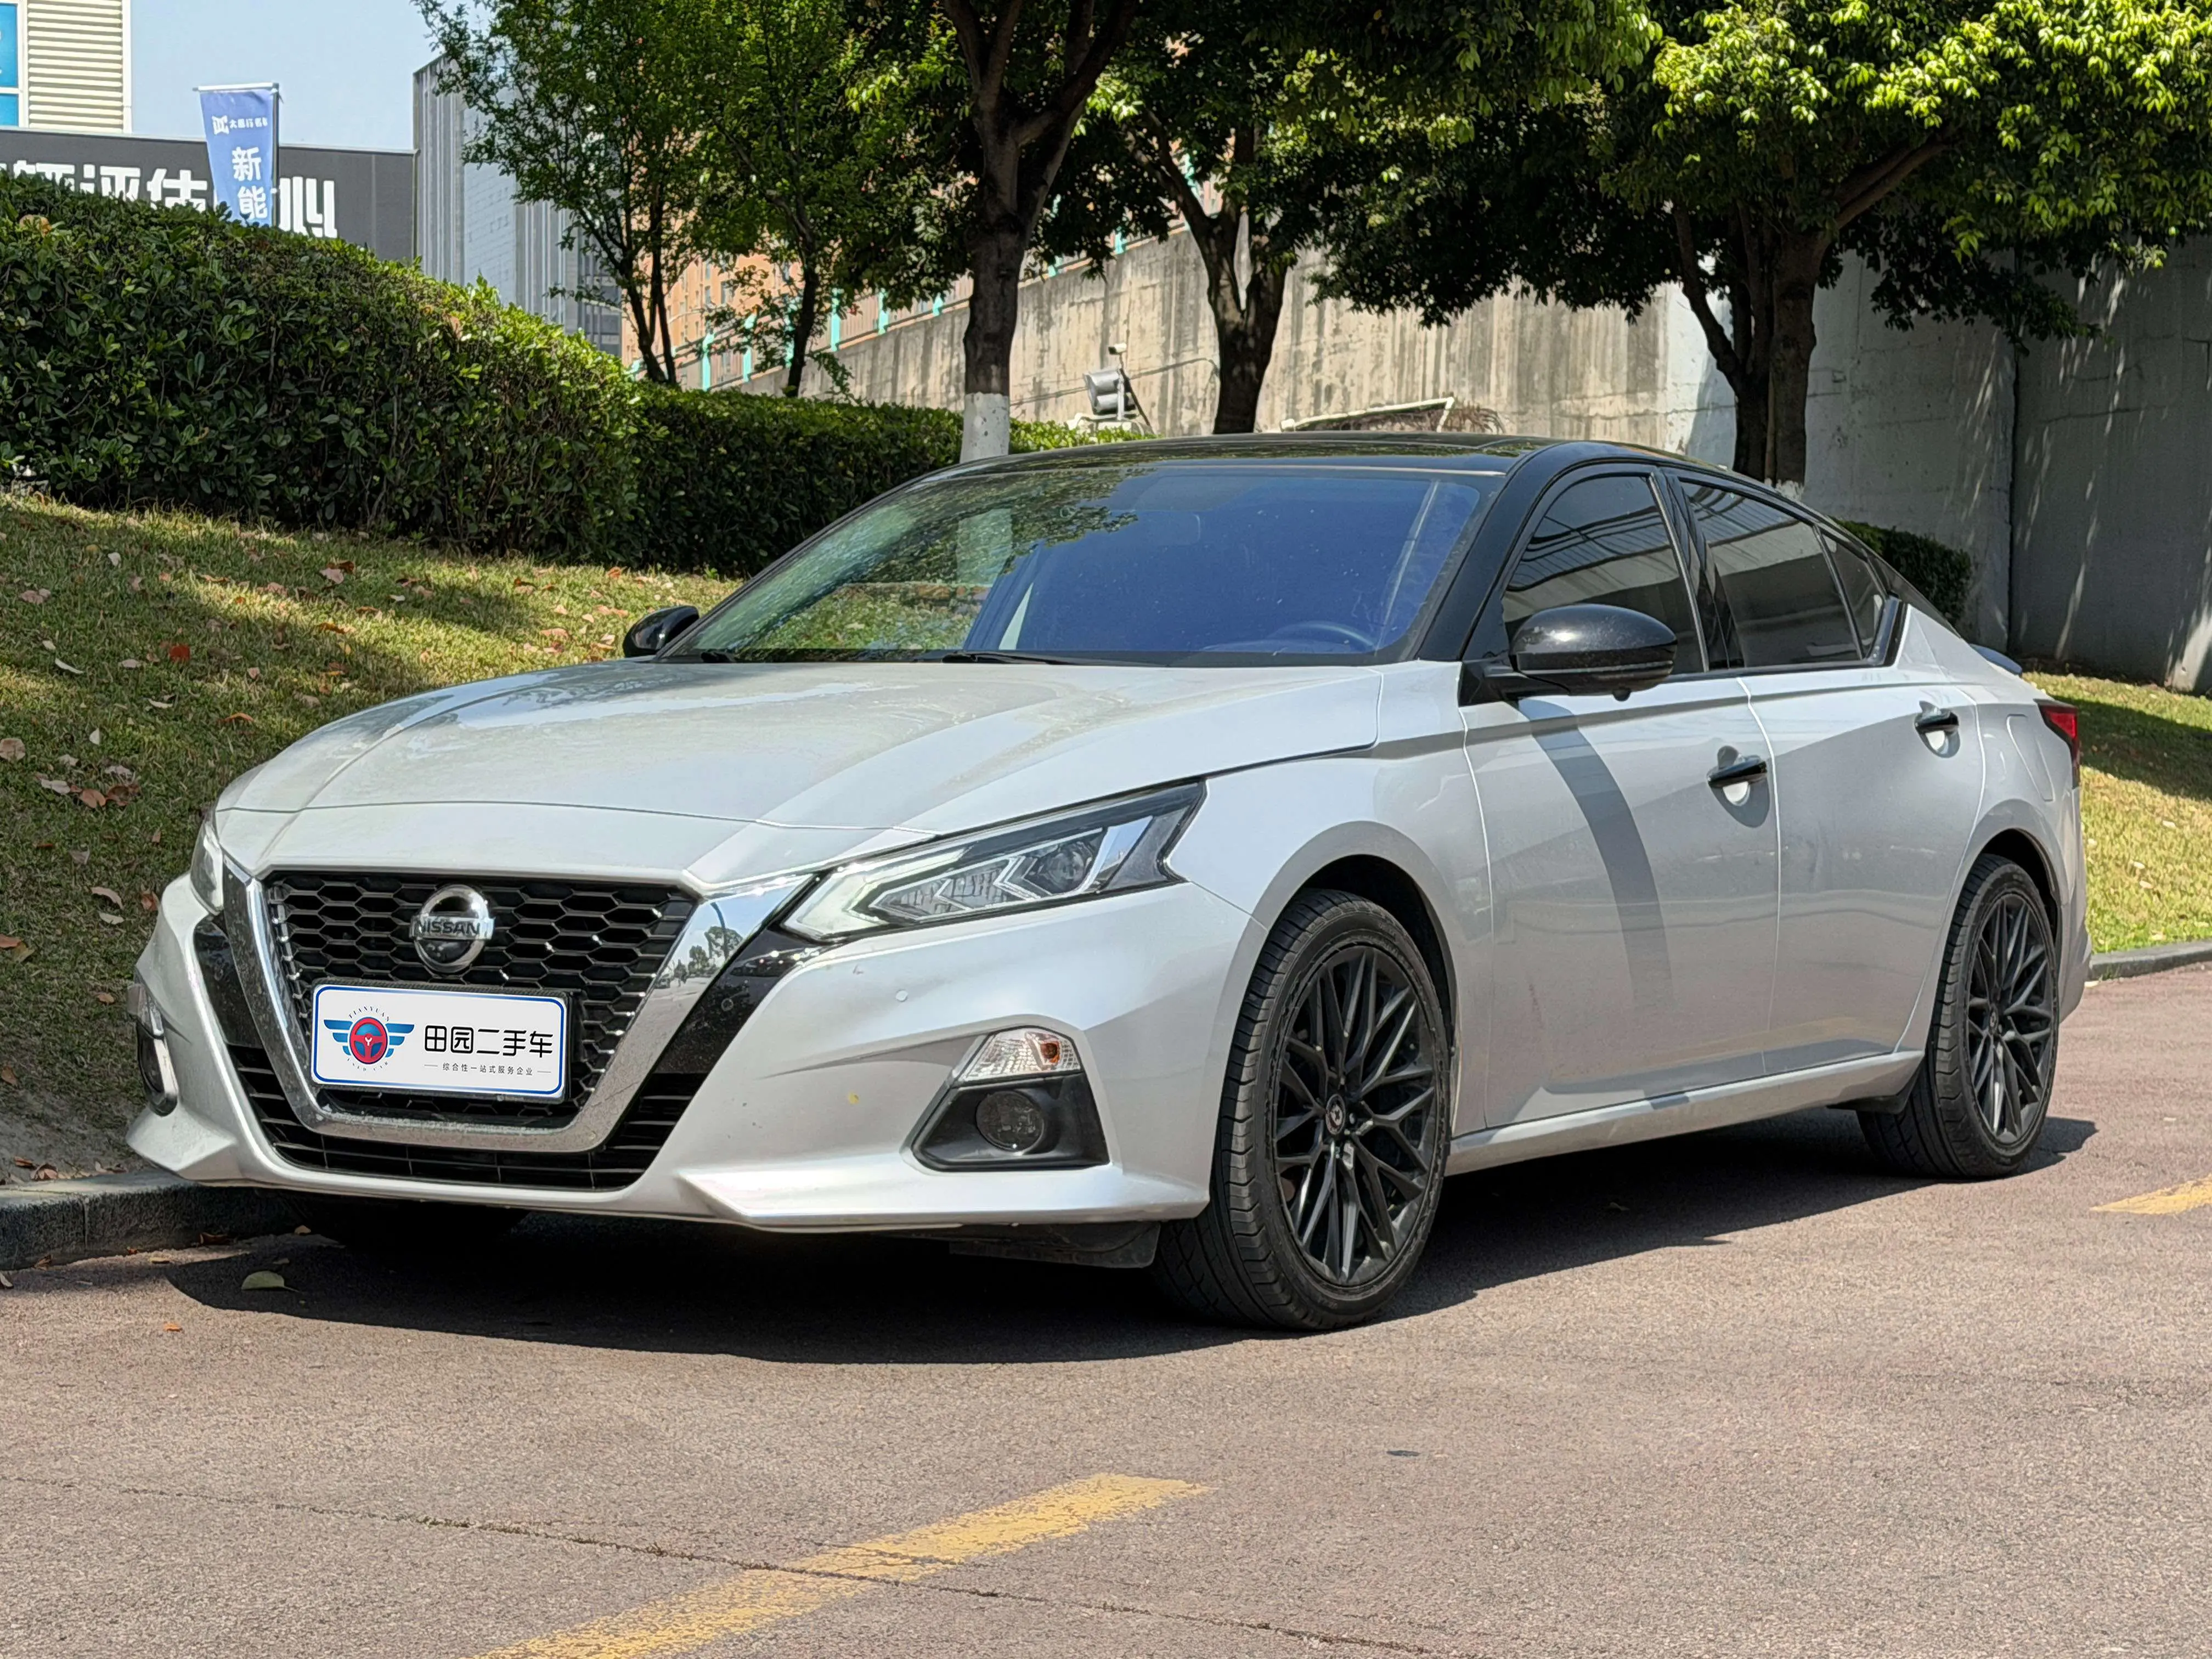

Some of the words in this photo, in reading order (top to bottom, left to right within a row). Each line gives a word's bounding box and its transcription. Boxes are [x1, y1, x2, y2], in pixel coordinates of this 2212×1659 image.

[414, 919, 481, 935] NISSAN
[425, 1025, 554, 1058] 田园二手车
[442, 1062, 533, 1076] 综合性一站式服务企业
